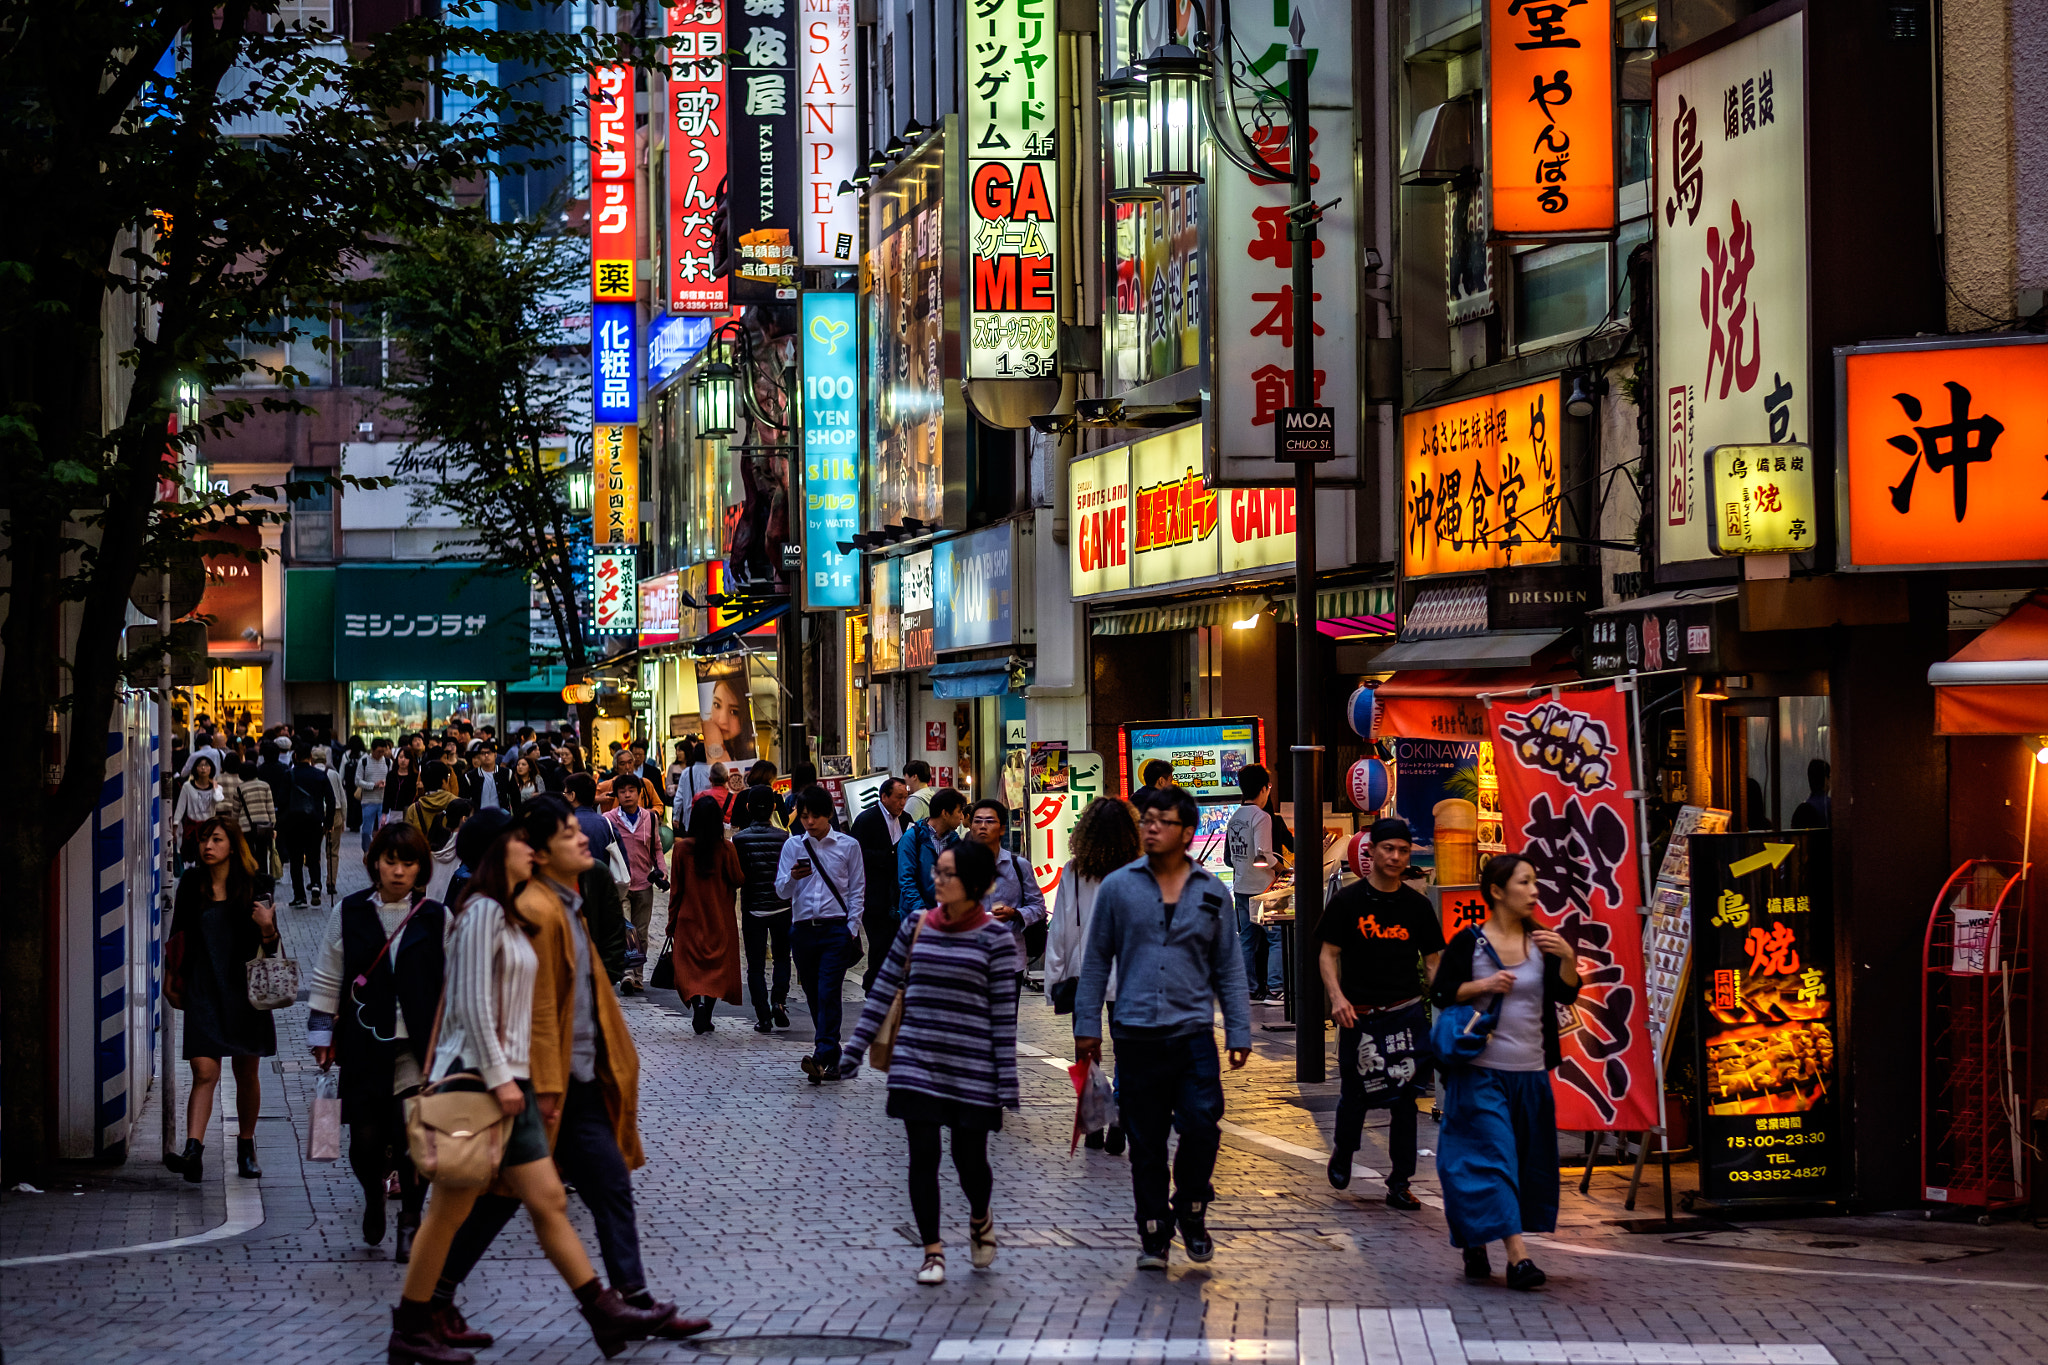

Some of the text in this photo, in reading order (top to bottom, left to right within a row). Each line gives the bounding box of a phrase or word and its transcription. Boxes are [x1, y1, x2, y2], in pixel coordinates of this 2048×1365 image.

[837, 0, 851, 95] 酒屋ダイニング
[1724, 69, 1775, 142] 備長炭
[804, 22, 834, 254] SANPEI
[1024, 131, 1053, 155] 4F
[1528, 70, 1573, 214] やんばる
[760, 124, 774, 222] KABUKIYA
[1666, 94, 1704, 228] 鳥
[677, 86, 721, 283] 歌うんだ村
[977, 218, 1047, 260] ゲーム
[599, 264, 630, 293] 薬
[742, 263, 794, 276] 高価買取
[1247, 125, 1327, 427] 三平本館
[1152, 252, 1199, 342] 食料品
[1699, 199, 1760, 403] 焼
[973, 316, 1054, 350] スポーツランド
[600, 319, 630, 408] 化粧品
[806, 376, 854, 400] 100
[813, 411, 849, 426] YEN
[1285, 413, 1332, 429] MOA
[806, 430, 856, 445] SHOP
[1286, 440, 1318, 450] CHUO
[808, 459, 855, 481] silk
[1672, 399, 1683, 513] 三八九
[1728, 456, 1804, 478] 鳥 備長炭
[808, 494, 855, 510] シルク
[1077, 483, 1128, 510] SPORTS LAND
[1408, 453, 1526, 560] 沖縄食堂
[1754, 483, 1782, 513] 焼
[809, 519, 855, 530] by WATTS
[1231, 488, 1296, 544] GAME
[1788, 518, 1807, 541] 亭
[1079, 505, 1127, 573] GAME
[822, 552, 844, 565] 1F
[597, 558, 619, 626] ラーメン
[815, 572, 852, 587] B1F
[962, 554, 983, 624] 100
[1509, 591, 1587, 605] DRESDEN
[345, 613, 487, 637] ミシンプラザ
[632, 691, 651, 699] MOA
[1400, 743, 1479, 760] OKINAWA
[1032, 794, 1067, 895] ダーツ
[1711, 889, 1750, 929] 鳥
[1766, 896, 1811, 913] 備長炭
[1744, 921, 1800, 976] 焼
[1797, 967, 1827, 1008] 亭
[1756, 1116, 1802, 1130] 営業時間
[1728, 1166, 1827, 1181] 03-3352-4827
[1766, 1153, 1796, 1164] TEL
